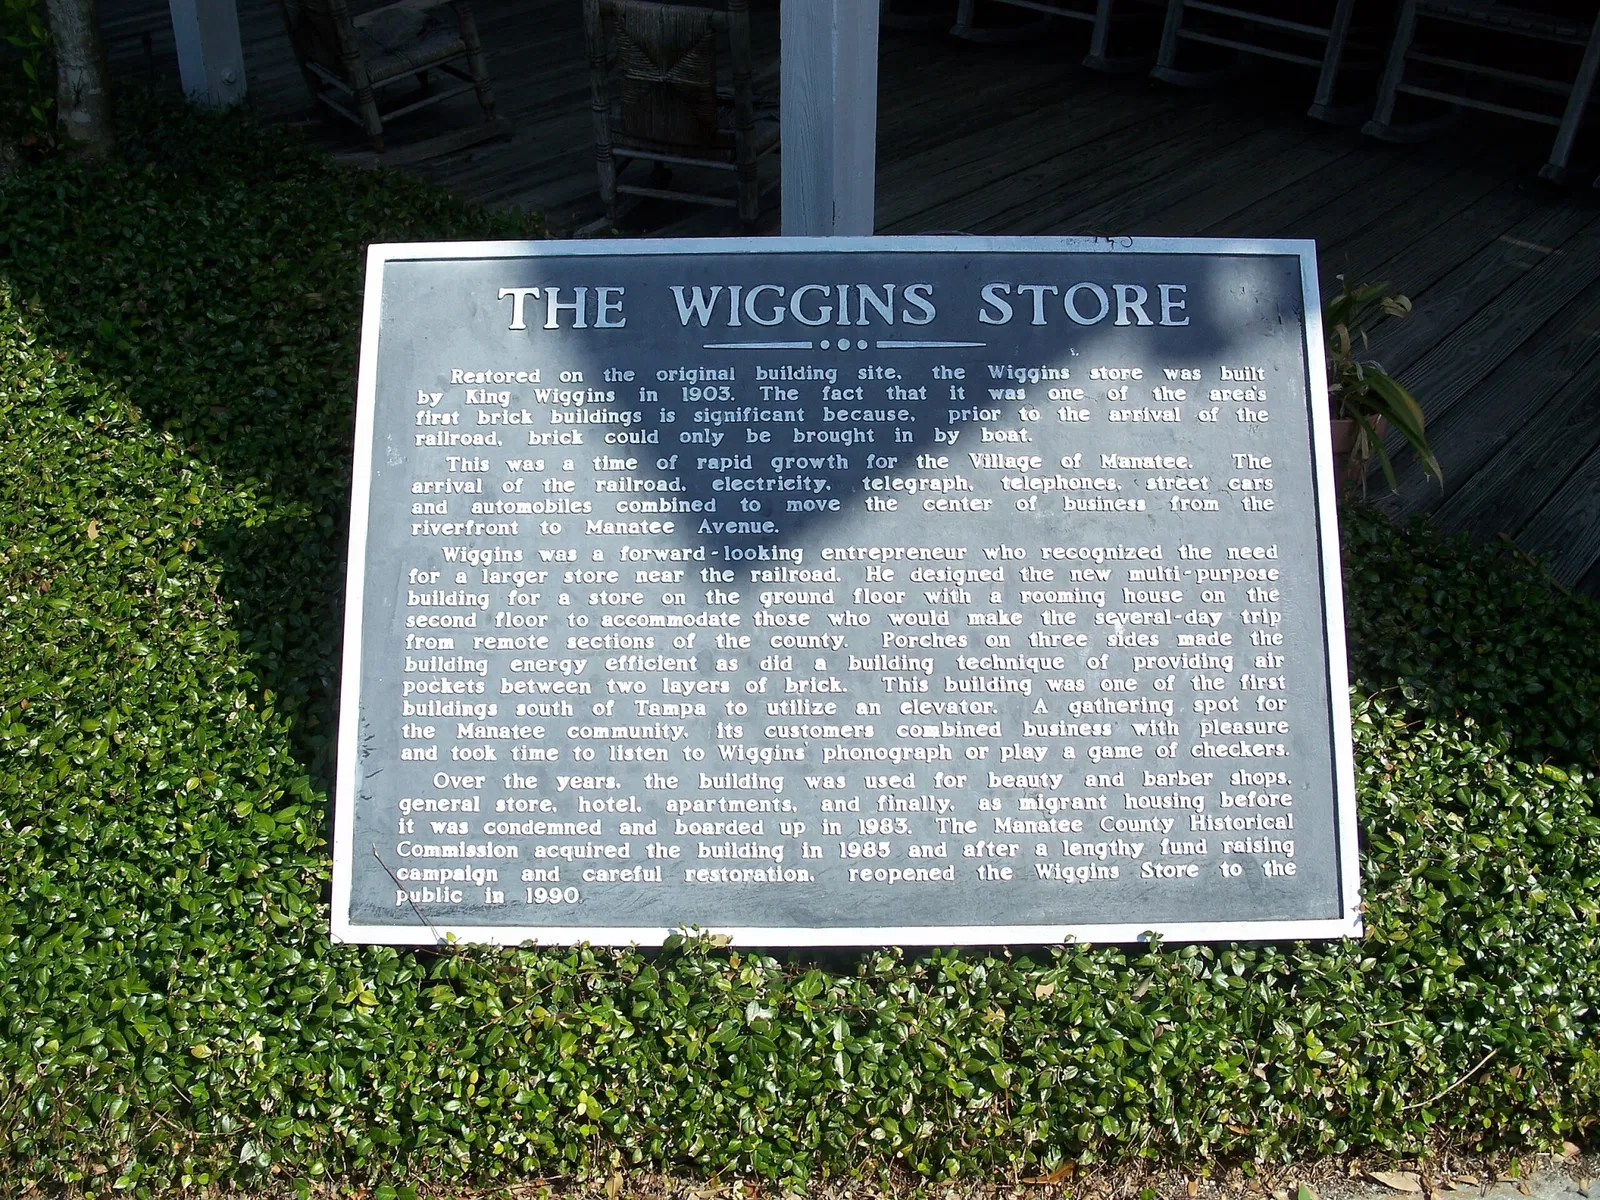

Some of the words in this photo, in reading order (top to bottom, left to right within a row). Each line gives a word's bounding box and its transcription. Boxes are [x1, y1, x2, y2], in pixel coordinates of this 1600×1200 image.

[498, 286, 627, 330] THE
[669, 283, 936, 327] WIGGINS
[978, 282, 1190, 326] STORE
[450, 368, 541, 384] Restored
[559, 370, 584, 383] on
[603, 367, 636, 382] the
[655, 366, 735, 385] original
[755, 365, 838, 385] building
[931, 364, 966, 380] the
[987, 364, 1070, 384] Wiggins
[1090, 365, 1143, 380] store
[1163, 368, 1202, 381] was
[1221, 365, 1266, 381] built
[416, 389, 444, 408] by
[465, 388, 511, 407] King
[534, 387, 615, 407] Wiggins
[639, 386, 658, 402] in
[681, 385, 735, 402] 1903.
[759, 385, 799, 401] The
[822, 385, 864, 401] fact
[885, 385, 927, 401] that
[949, 384, 966, 400] it
[987, 388, 1026, 400] was
[1048, 388, 1085, 400] one
[1107, 385, 1129, 401] of
[1152, 385, 1187, 401] the
[1210, 385, 1267, 401] area's
[415, 409, 460, 426] first
[477, 408, 534, 425] brick
[550, 408, 642, 427] buildings
[659, 407, 676, 423] is
[693, 406, 805, 427] significant
[948, 406, 1001, 425] prior
[1018, 406, 1041, 422] to
[1057, 405, 1091, 422] the
[1109, 406, 1181, 422] arrival
[1198, 406, 1220, 422] of
[1236, 406, 1269, 422] the
[445, 456, 490, 472] This
[505, 459, 545, 471] was
[562, 458, 575, 471] a
[592, 455, 638, 471] time
[656, 454, 679, 470] of
[696, 454, 753, 473] rapid
[770, 454, 849, 473] growth
[866, 453, 898, 469] for
[915, 453, 949, 469] the
[968, 452, 1043, 473] Village
[1061, 452, 1083, 468] of
[1101, 453, 1193, 469] Manatee.
[1232, 453, 1272, 469] The
[411, 499, 448, 515] and
[471, 497, 592, 514] automobiles
[616, 496, 717, 513] combined
[739, 497, 761, 512] to
[786, 498, 841, 512] move
[864, 495, 898, 512] the
[923, 496, 993, 511] center
[1016, 495, 1038, 511] of
[1064, 495, 1146, 511] business
[1170, 495, 1220, 511] from
[1241, 495, 1275, 511] the
[411, 519, 519, 536] riverfront
[539, 520, 562, 535] to
[585, 519, 675, 535] Manatee
[697, 518, 779, 534] Avenue.
[408, 567, 441, 584] for
[455, 571, 468, 584] a
[482, 568, 549, 588] larger
[563, 568, 619, 583] store
[635, 570, 685, 583] near
[699, 567, 735, 583] the
[750, 566, 842, 583] railroad.
[866, 565, 895, 582] He
[910, 565, 1005, 586] designed
[1019, 566, 1054, 581] the
[1070, 569, 1112, 581] new
[1129, 565, 1280, 584] multi-purpose
[405, 633, 455, 650] from
[473, 634, 549, 650] remote
[567, 632, 655, 649] sections
[673, 632, 696, 649] of
[715, 632, 751, 649] the
[770, 632, 849, 651] county.
[882, 631, 968, 648] Porches
[985, 634, 1011, 648] on
[1028, 631, 1088, 647] three
[1107, 631, 1160, 649] sides
[1177, 630, 1233, 646] made
[1250, 629, 1284, 646] the
[402, 678, 485, 697] pockets
[500, 677, 592, 694] between
[606, 678, 647, 694] two
[662, 677, 730, 696] layers
[745, 676, 768, 693] of
[785, 676, 848, 693] brick.
[882, 675, 929, 692] This
[945, 675, 1032, 696] building
[1046, 678, 1086, 692] was
[1100, 678, 1138, 692] one
[1154, 674, 1176, 691] of
[1191, 674, 1225, 691] the
[1240, 673, 1286, 690] first
[402, 699, 498, 721] buildings
[516, 699, 574, 716] south
[592, 699, 615, 716] of
[634, 699, 707, 719] Tampa
[725, 699, 748, 716] to
[767, 698, 837, 715] utilize
[856, 702, 882, 716] an
[900, 698, 998, 715] elevator.
[1033, 697, 1049, 714] A
[1069, 696, 1174, 718] gathering
[1194, 696, 1239, 715] spot
[1256, 695, 1288, 711] for
[398, 817, 415, 834] it
[430, 821, 469, 835] was
[483, 818, 602, 835] condemned
[619, 819, 657, 836] and
[674, 818, 765, 835] boarded
[779, 821, 806, 838] up
[822, 818, 842, 835] in
[858, 817, 913, 835] 1983.
[935, 817, 977, 834] The
[994, 816, 1083, 834] Manatee
[1100, 815, 1175, 834] County
[1190, 813, 1294, 831] Historical
[396, 840, 519, 858] Commission
[534, 841, 631, 862] acquired
[645, 841, 681, 859] the
[697, 841, 785, 863] building
[802, 841, 824, 859] in
[839, 840, 891, 858] 1985
[908, 841, 948, 858] and
[963, 840, 1020, 857] after
[1035, 843, 1048, 857] a
[1062, 838, 1145, 861] lengthy
[1160, 837, 1208, 855] fund
[1222, 836, 1295, 858] raising
[396, 864, 499, 886] campaign
[521, 865, 560, 882] and
[582, 865, 663, 882] careful
[848, 864, 955, 885] reopened
[977, 863, 1013, 881] the
[1034, 862, 1120, 884] Wiggins
[1141, 861, 1199, 879] Store
[1220, 860, 1243, 879] to
[1262, 859, 1297, 879] the
